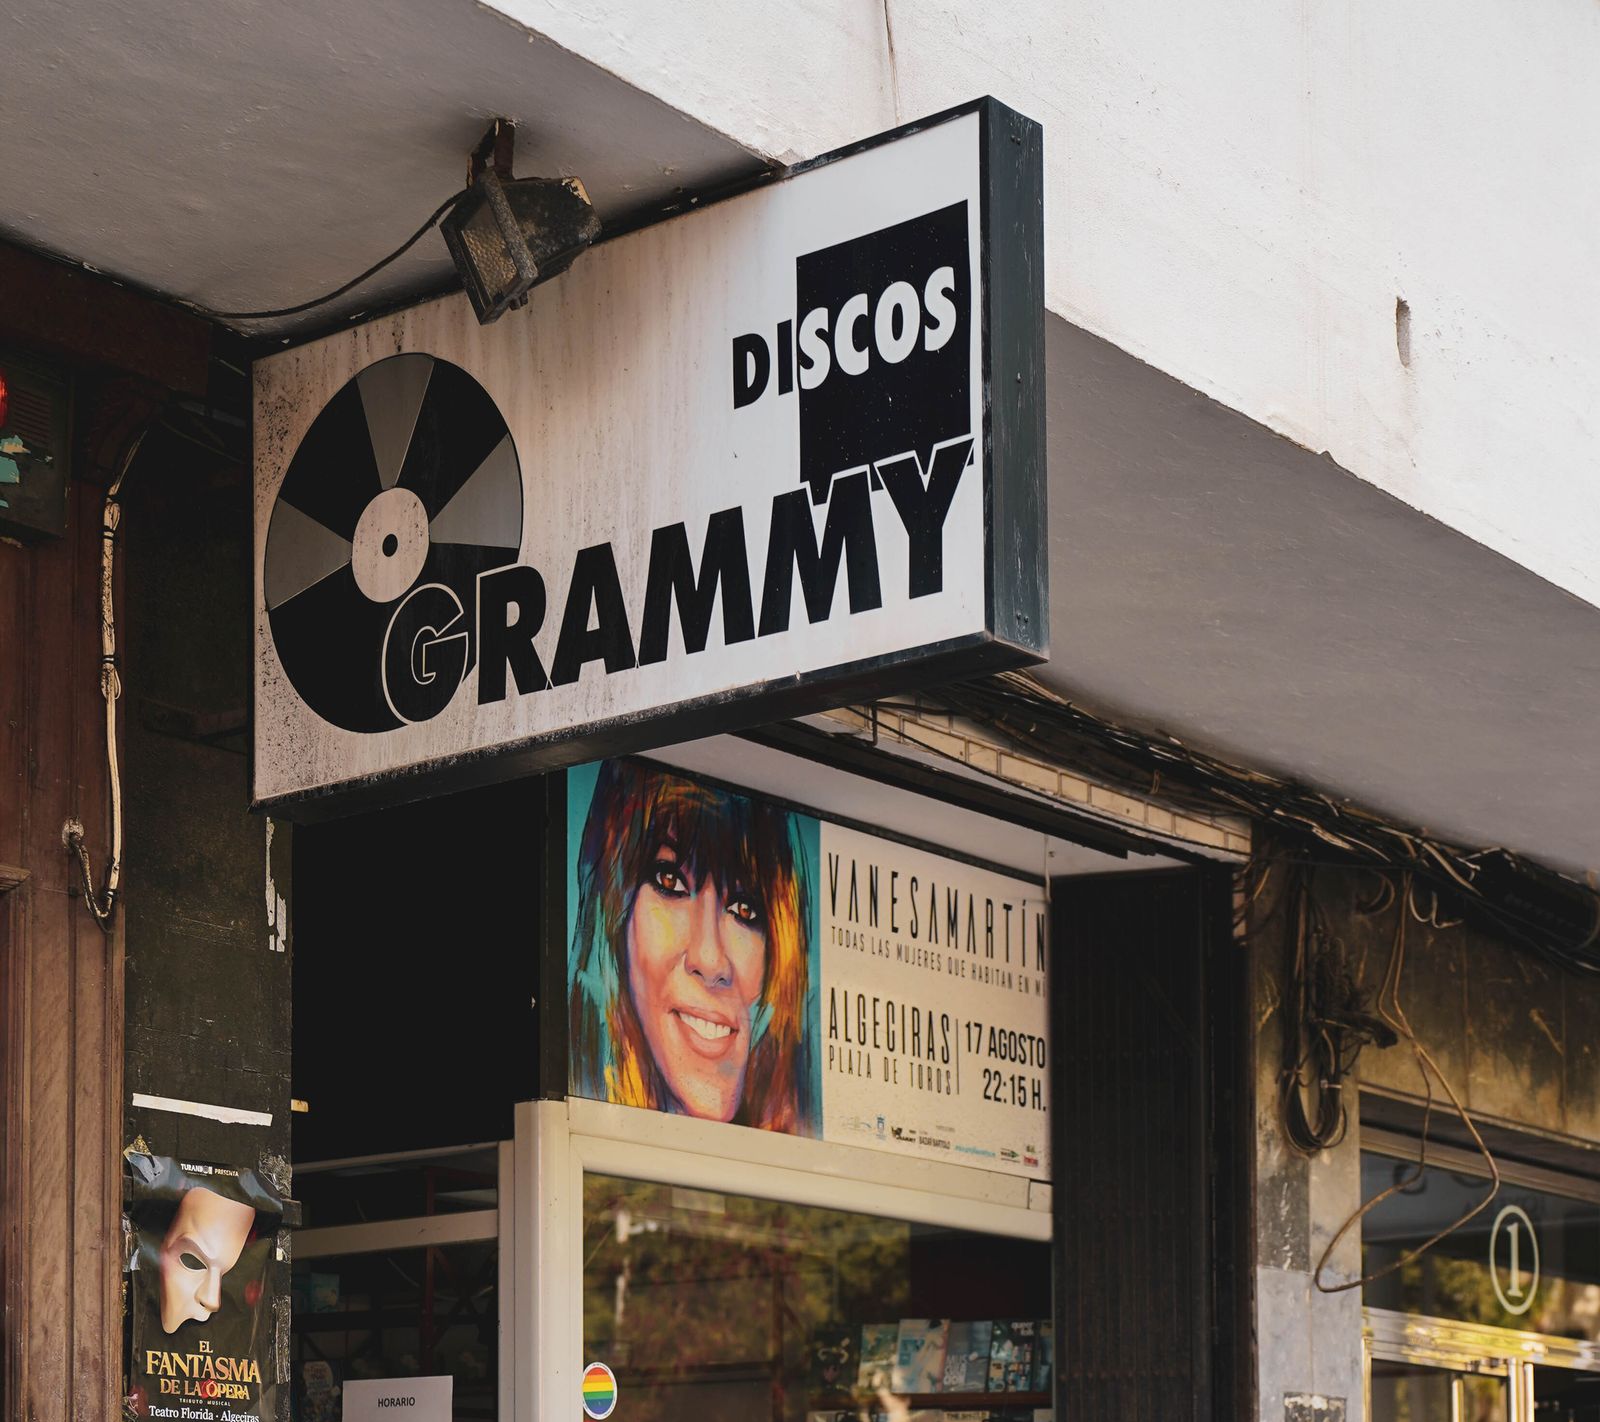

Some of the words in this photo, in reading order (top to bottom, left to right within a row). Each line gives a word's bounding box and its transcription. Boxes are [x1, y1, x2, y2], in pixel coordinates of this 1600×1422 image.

[733, 266, 957, 409] DISCOS
[381, 438, 974, 728] GRAMMY
[832, 926, 863, 953] TODAS
[872, 936, 889, 959] LAS
[897, 943, 941, 971] MUJERES
[948, 957, 966, 978] QUE
[972, 963, 1012, 990] HABITAN
[1018, 974, 1029, 994] EN
[829, 987, 950, 1064] ALGECIRAS
[965, 1021, 983, 1054] 17
[988, 1026, 1046, 1068] AGOSTO
[829, 1045, 872, 1079] PLAZA
[884, 1057, 899, 1084] DE
[910, 1062, 951, 1095] TOROS
[983, 1068, 1026, 1107] 22:15
[1032, 1078, 1047, 1112] H.
[146, 1350, 262, 1384] FANTASMA
[199, 1340, 213, 1353] EL
[160, 1379, 180, 1395] DE
[184, 1380, 202, 1396] LA
[377, 1397, 415, 1408] HORARIO
[148, 1405, 179, 1418] Teatro
[181, 1408, 214, 1421] Florida
